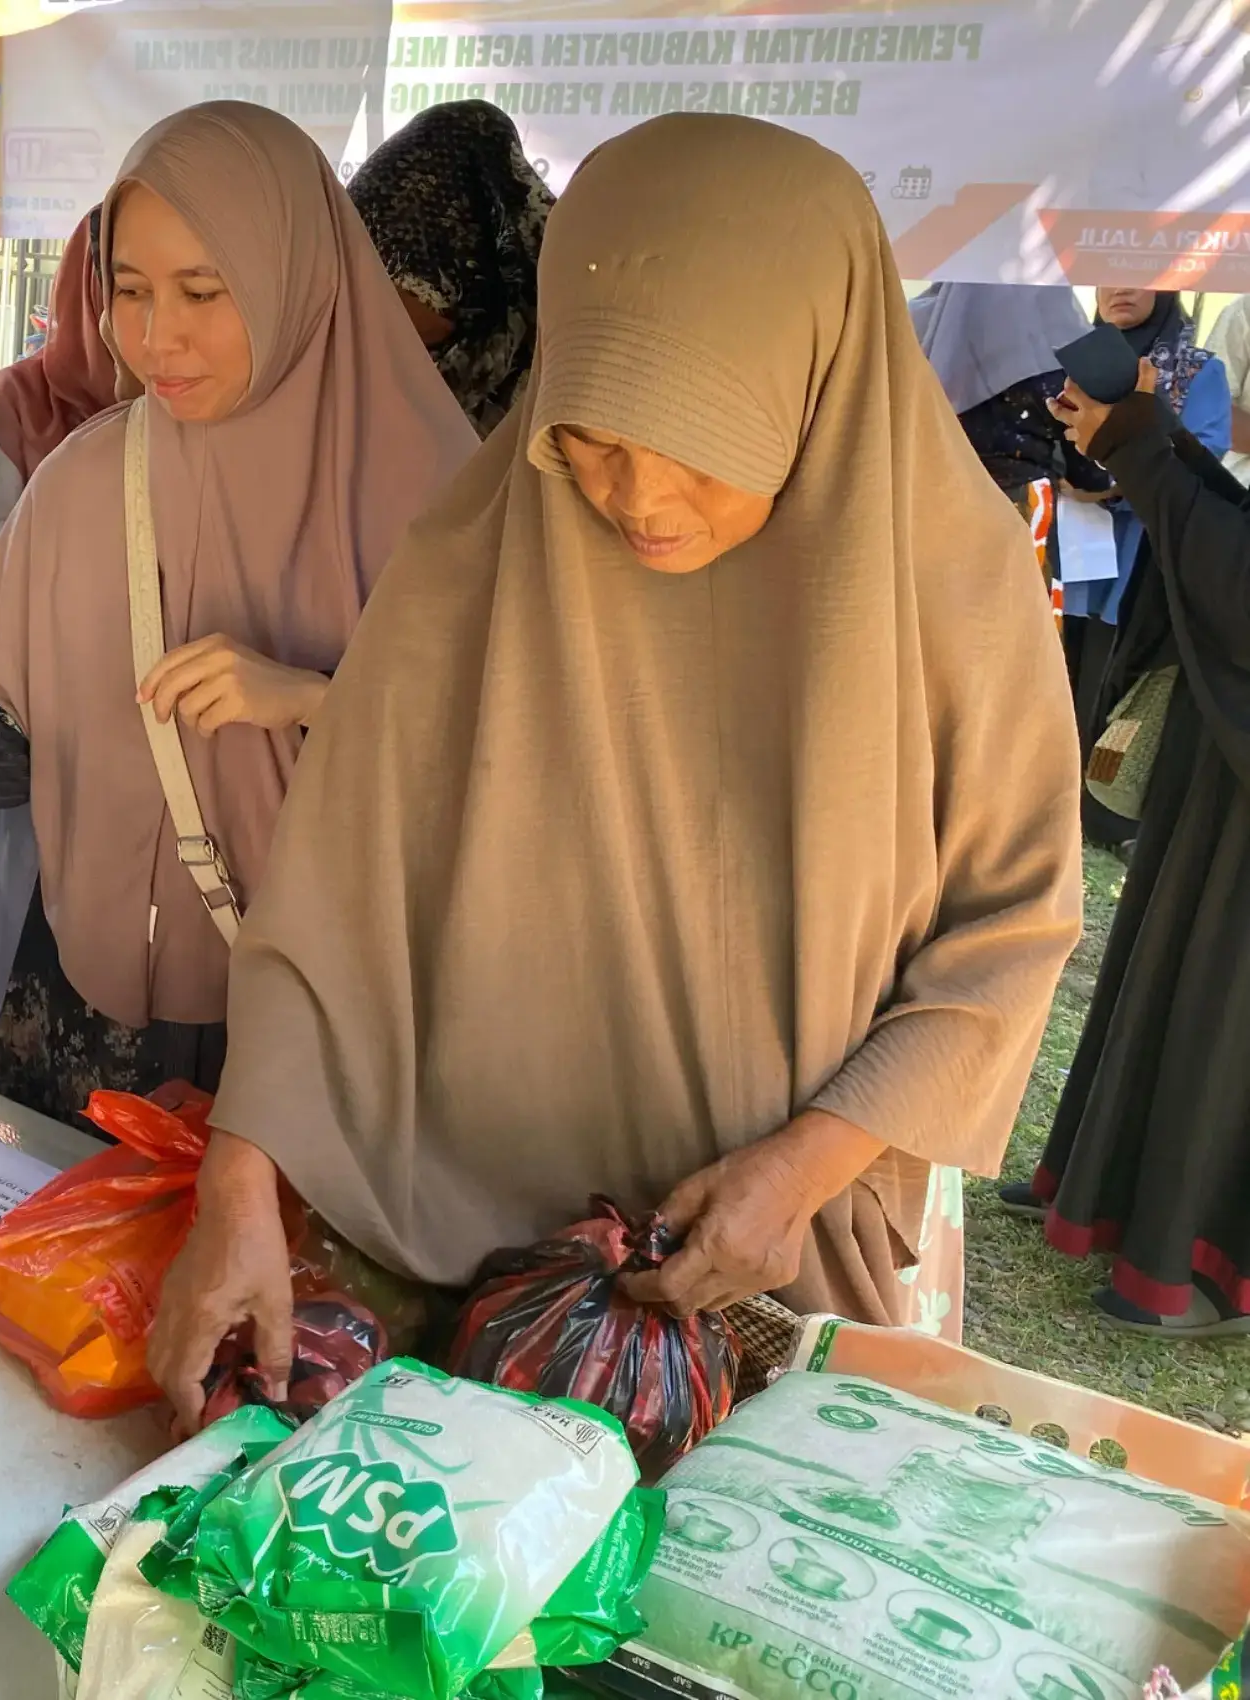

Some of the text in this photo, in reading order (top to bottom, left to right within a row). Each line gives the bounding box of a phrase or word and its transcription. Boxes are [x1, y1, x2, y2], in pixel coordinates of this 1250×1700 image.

[408, 1422, 438, 1433] GULA
[290, 1460, 447, 1549] PSM
[797, 1518, 1005, 1617] PETUNJUK CARA MEMASAK
[631, 1655, 651, 1668] SAP
[672, 1674, 692, 1689] SAP
[707, 1621, 858, 1700] KP ECCO
[794, 1642, 864, 1684] Produksi
